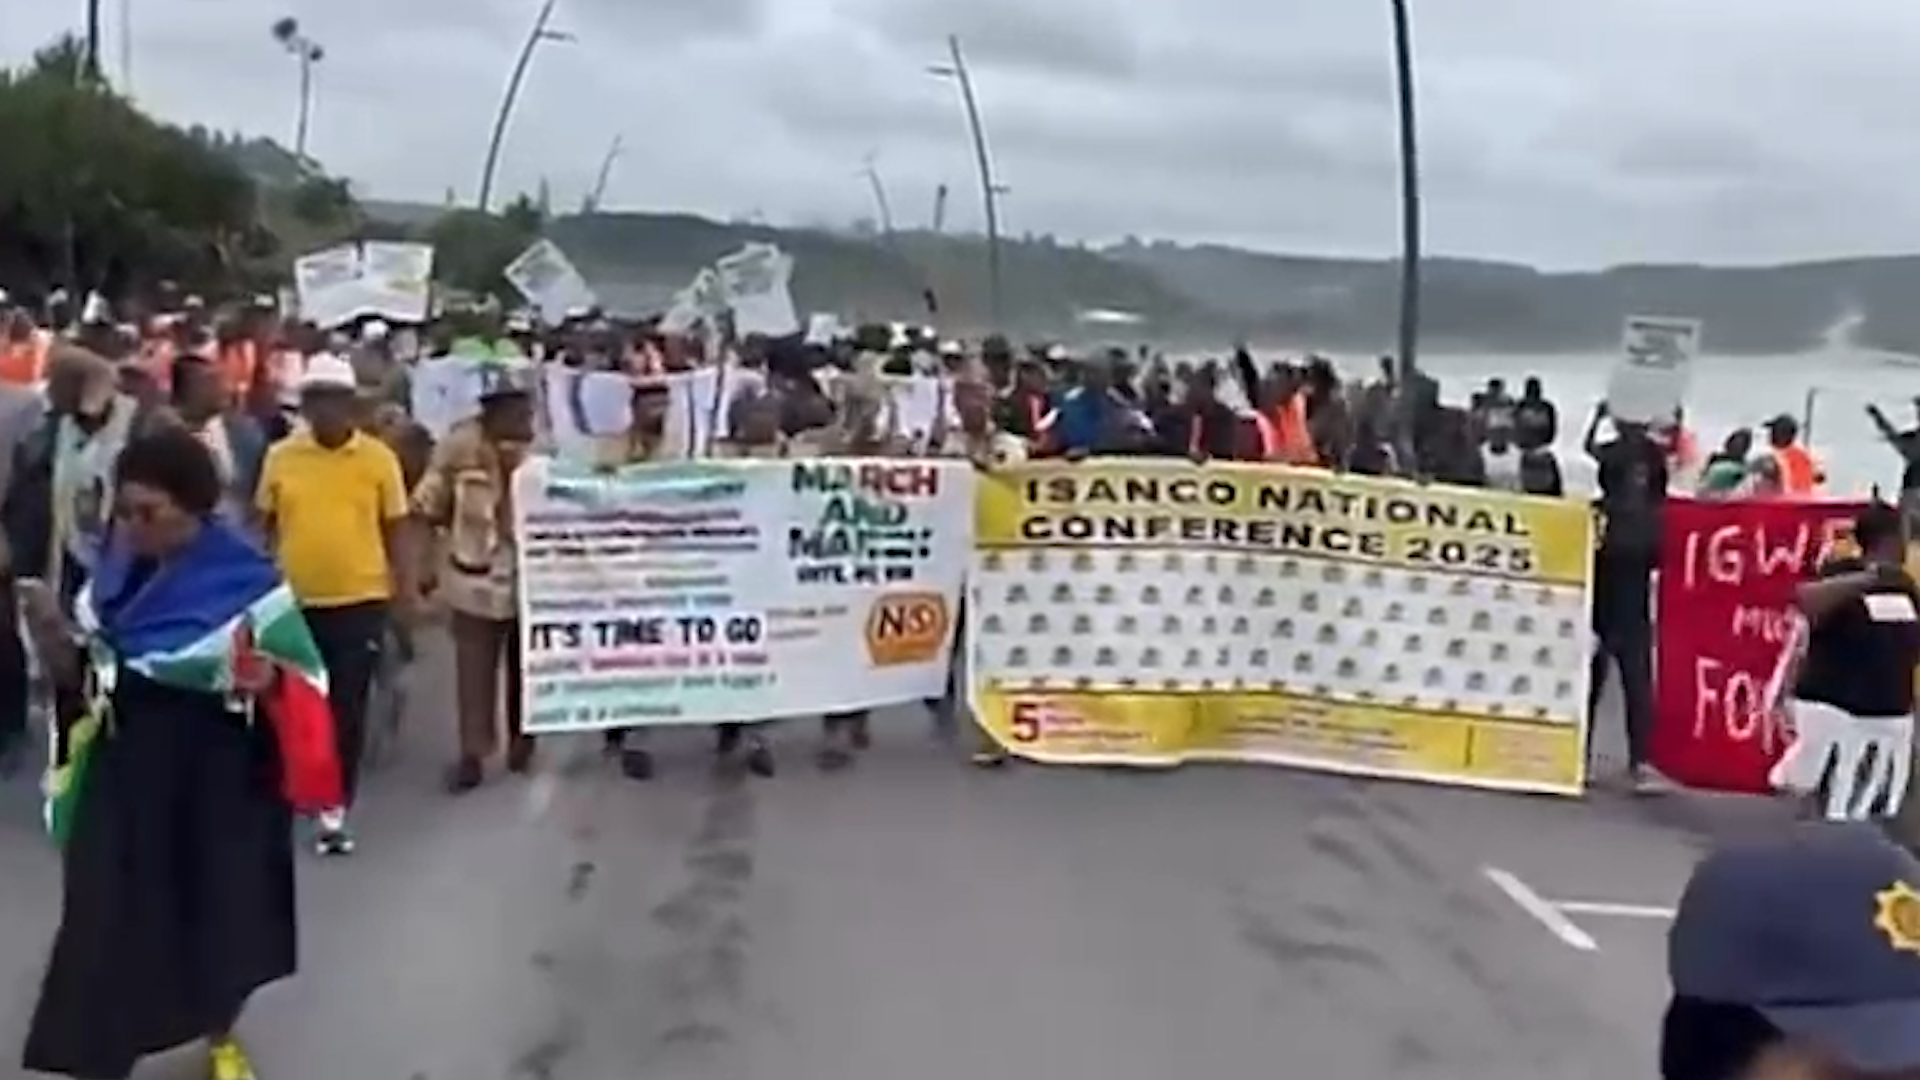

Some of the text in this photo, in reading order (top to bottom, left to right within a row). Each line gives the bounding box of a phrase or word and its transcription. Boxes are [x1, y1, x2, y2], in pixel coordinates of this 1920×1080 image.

[792, 462, 939, 497] MARCH
[820, 496, 909, 526] AND
[1259, 485, 1530, 537] NATIONAL
[1021, 515, 1533, 573] CONFERENCE 2025
[593, 617, 667, 647] TIME
[675, 617, 716, 646] TO
[725, 616, 762, 645] GO
[1012, 702, 1038, 742] 5
